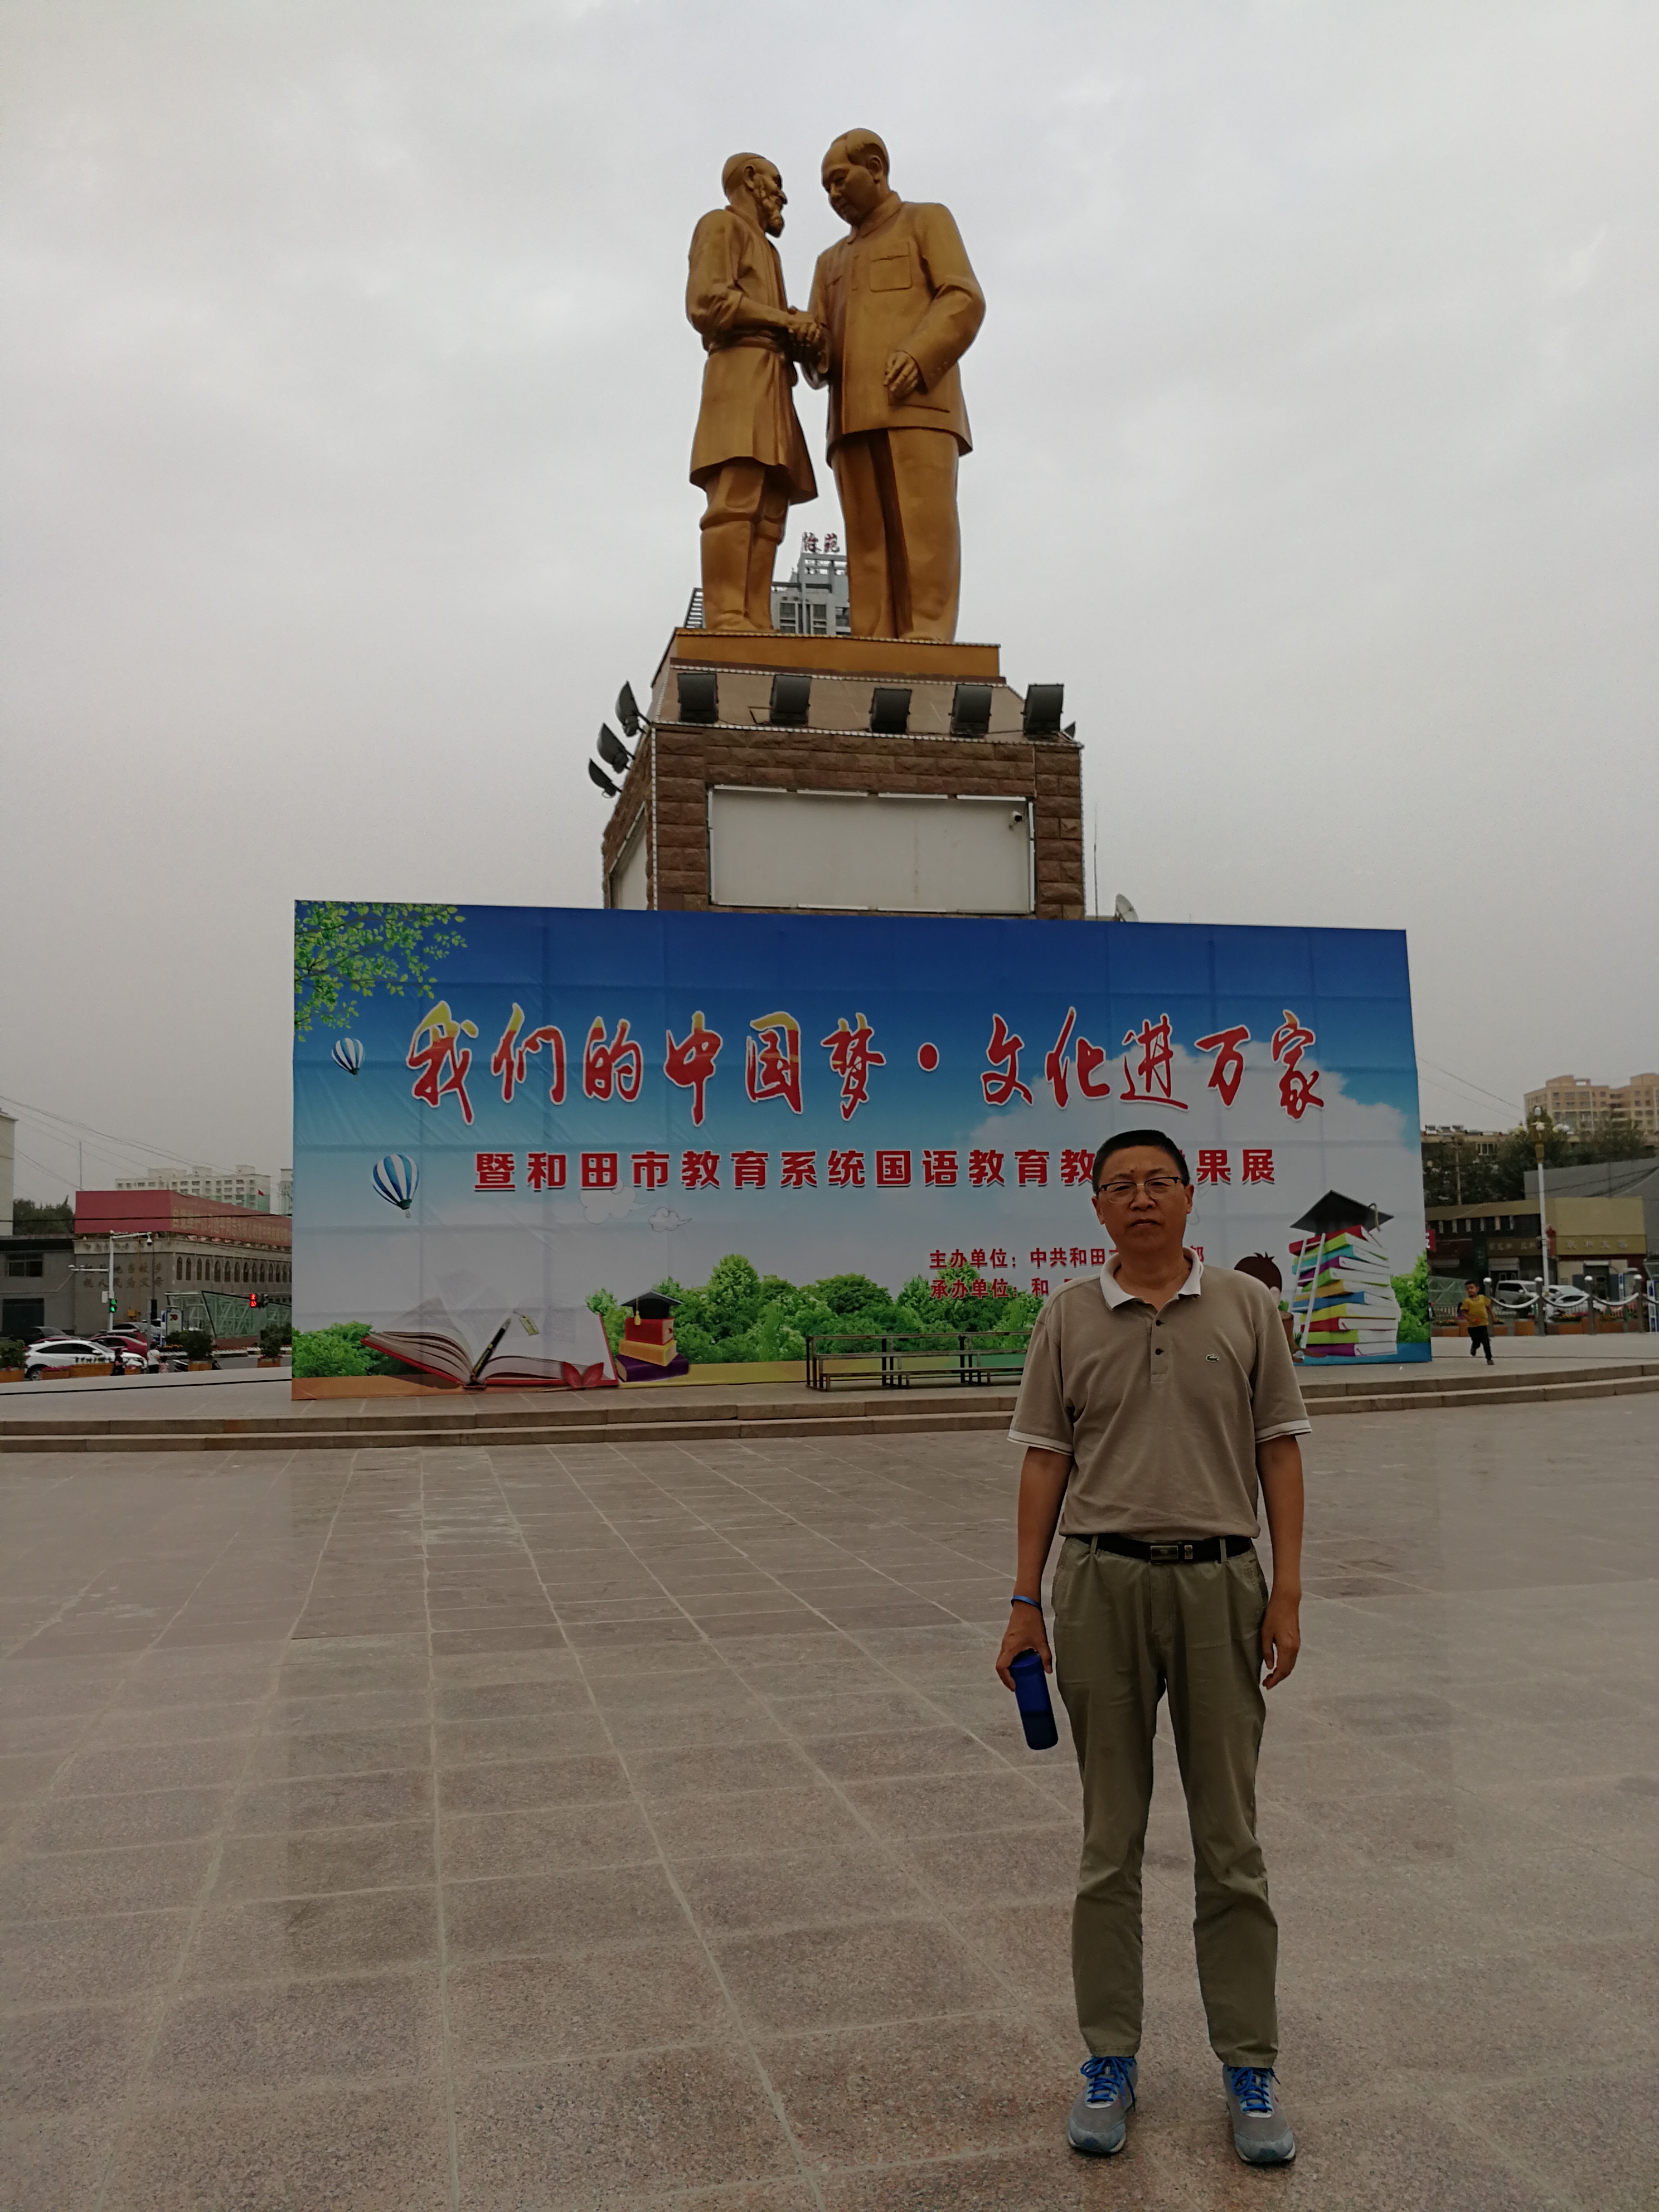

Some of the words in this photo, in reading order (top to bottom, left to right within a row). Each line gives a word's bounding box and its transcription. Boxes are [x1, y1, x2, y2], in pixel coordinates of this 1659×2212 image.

[474, 1148, 1275, 1190] 暨和田市教育系统国语教育教果展
[929, 1247, 1119, 1269] 主办单位：中共和田
[930, 1278, 1073, 1299] 承办单位：和
